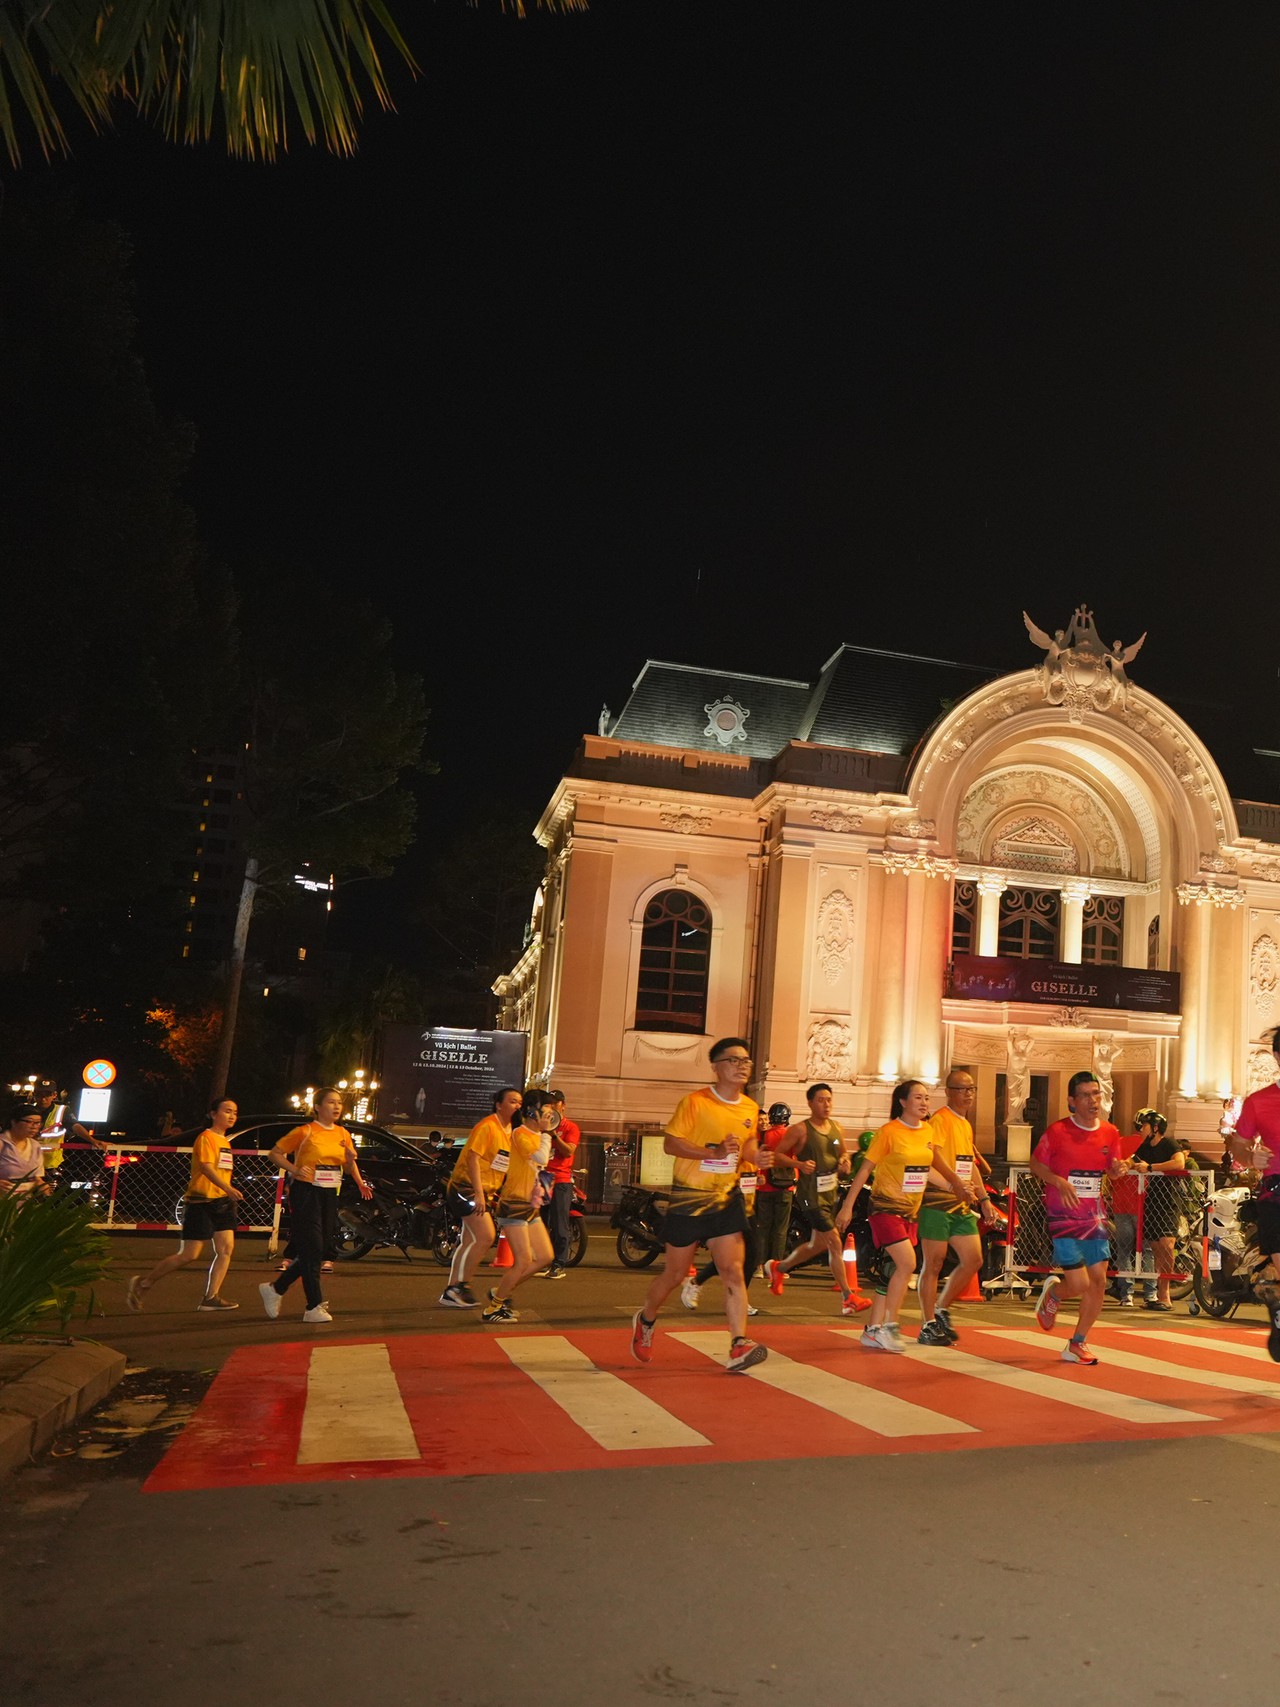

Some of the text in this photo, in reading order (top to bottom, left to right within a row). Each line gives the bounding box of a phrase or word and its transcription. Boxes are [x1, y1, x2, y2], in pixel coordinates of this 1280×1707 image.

[1031, 981, 1098, 996] GISELLE
[460, 1043, 477, 1051] Ballet
[420, 1050, 489, 1064] GISELLE
